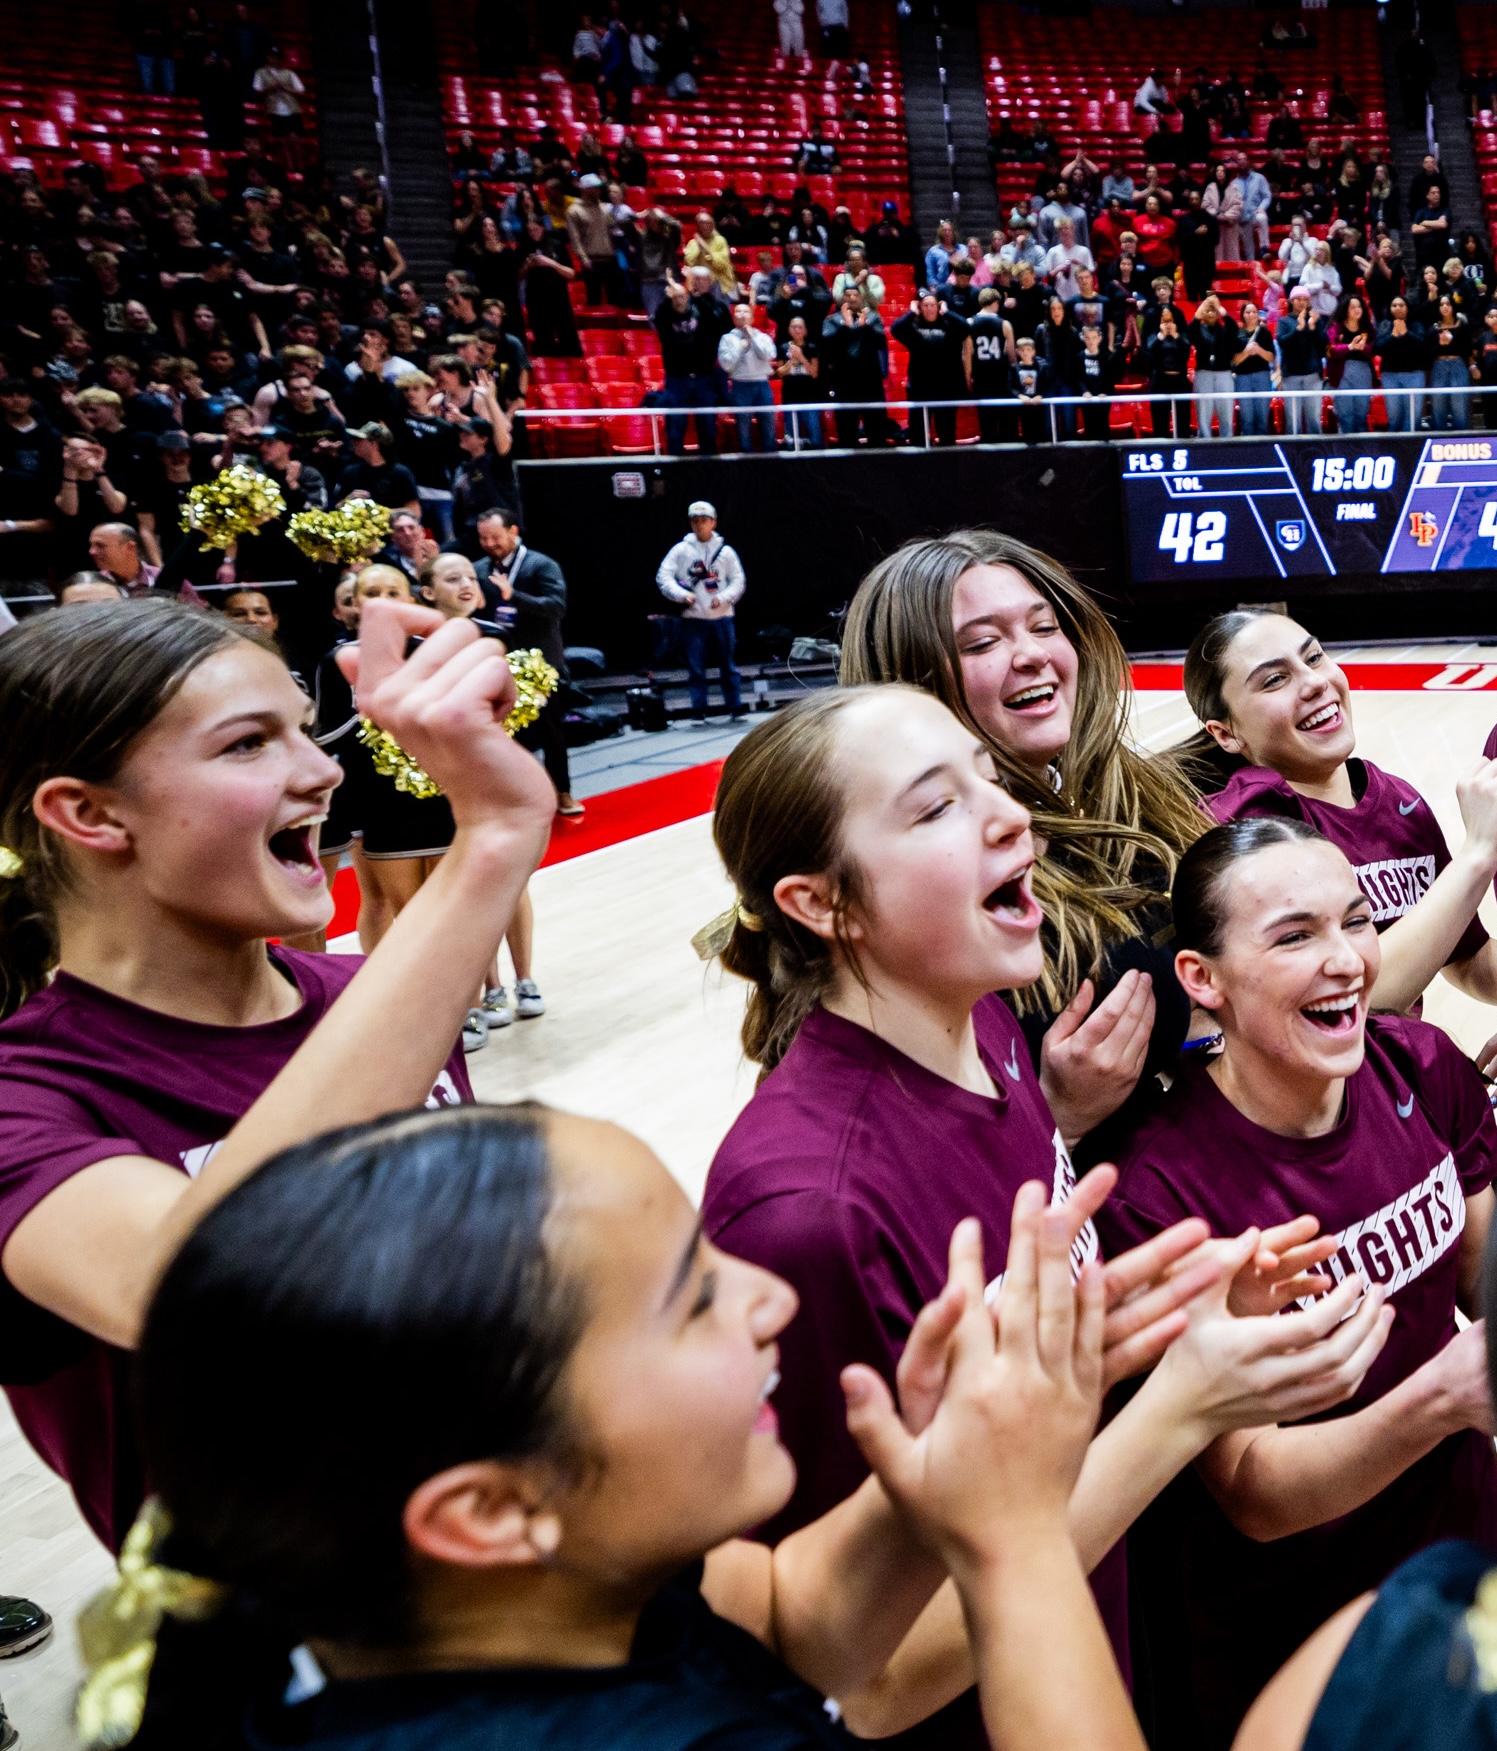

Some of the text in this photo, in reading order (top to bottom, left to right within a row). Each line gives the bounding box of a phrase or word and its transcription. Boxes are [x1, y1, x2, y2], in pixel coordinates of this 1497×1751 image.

[976, 335, 1000, 360] 24
[1129, 449, 1188, 470] FLS 5
[1431, 443, 1492, 460] BONUS
[1173, 477, 1203, 491] TOL
[1312, 456, 1395, 492] 15:00
[1336, 503, 1377, 520] FINAL
[1158, 511, 1227, 563] 42
[1357, 865, 1430, 912] IGHTS
